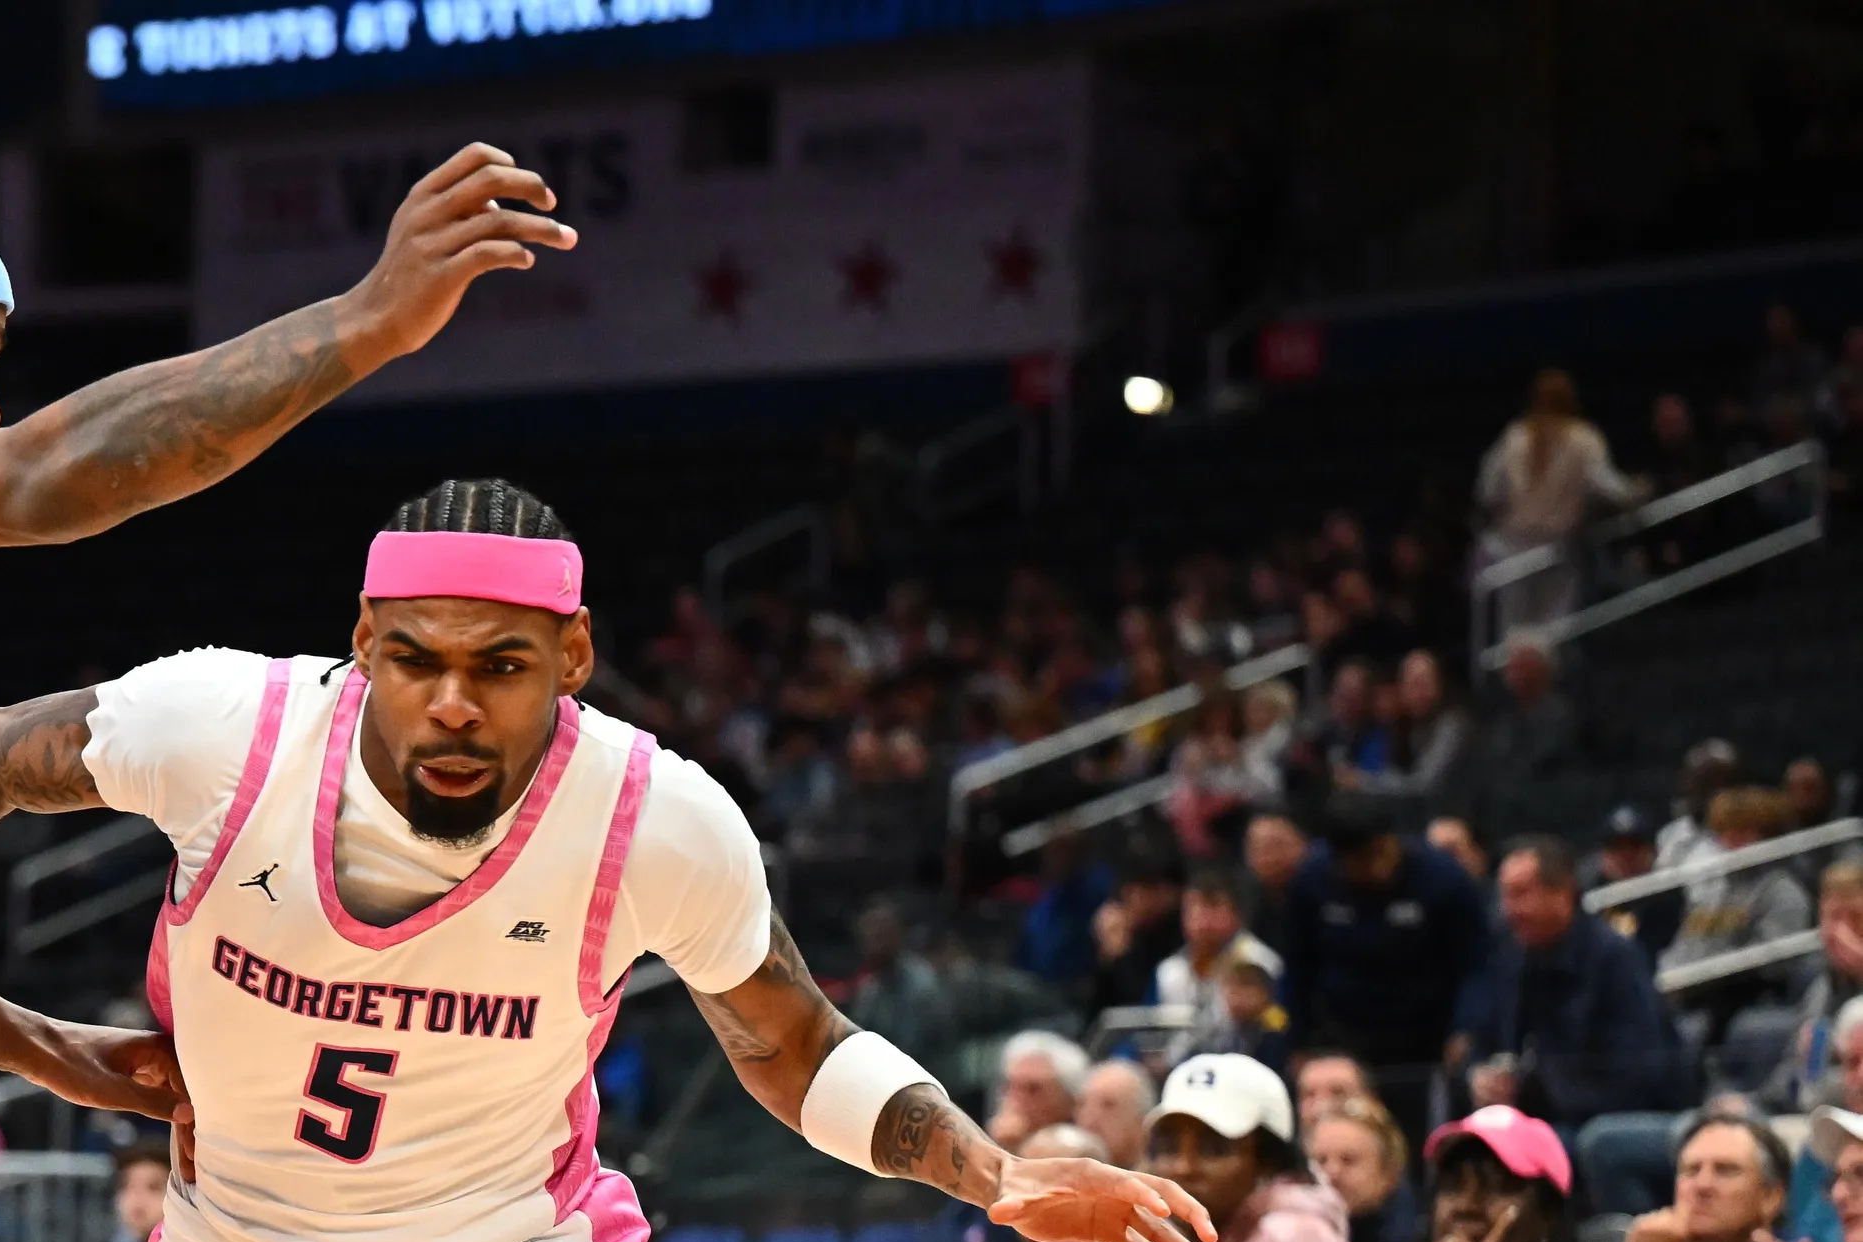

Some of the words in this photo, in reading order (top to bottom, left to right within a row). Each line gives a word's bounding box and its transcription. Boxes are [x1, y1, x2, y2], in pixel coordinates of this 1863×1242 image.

[508, 927, 551, 936] EAST
[514, 920, 545, 929] BIG
[212, 935, 540, 1040] GEORGETOWN
[293, 1042, 400, 1164] 5
